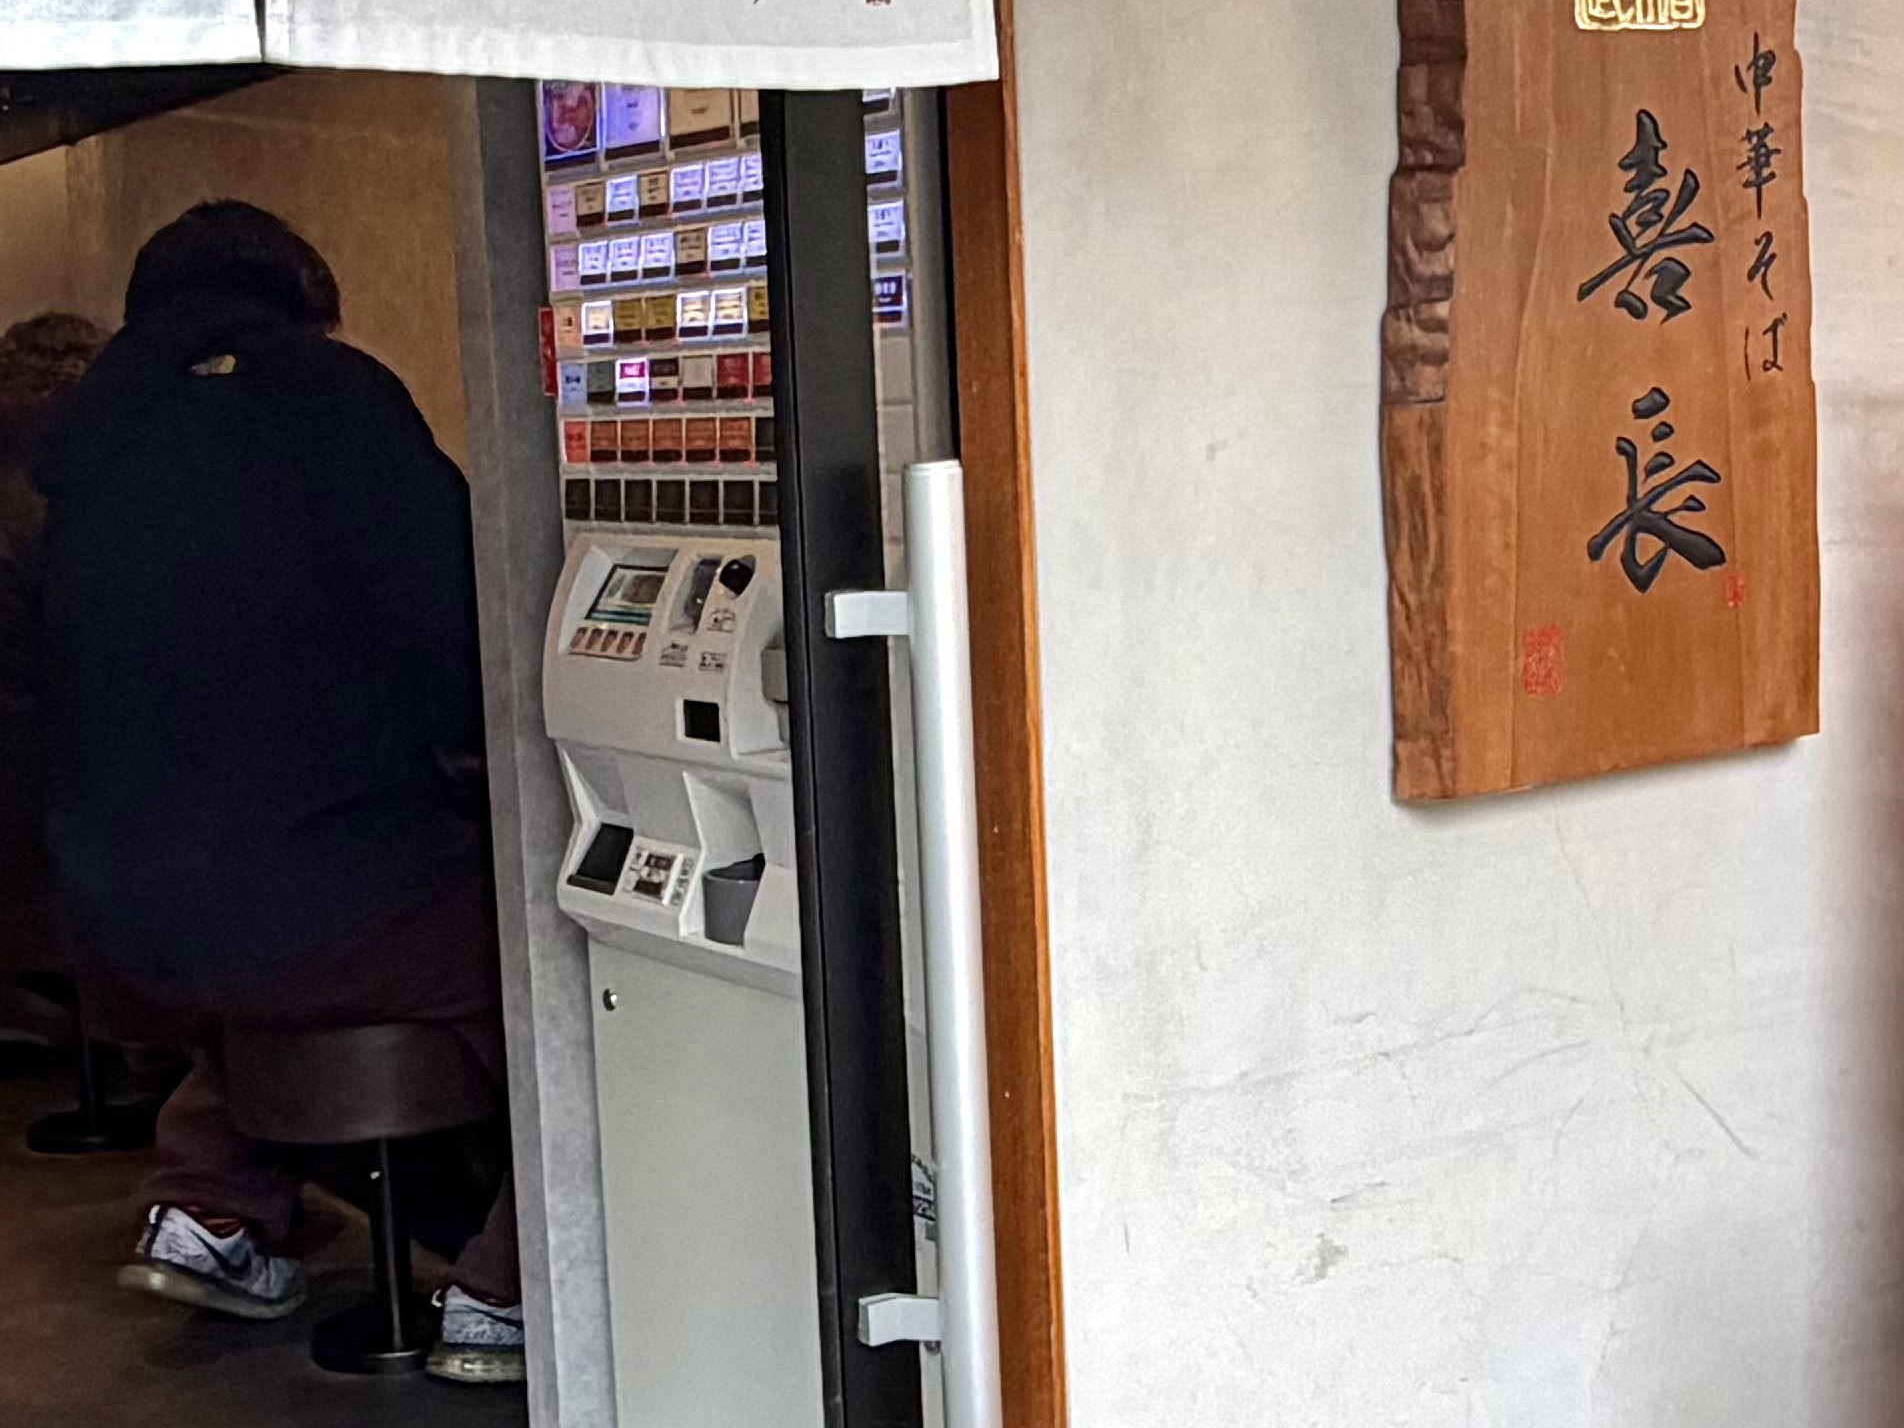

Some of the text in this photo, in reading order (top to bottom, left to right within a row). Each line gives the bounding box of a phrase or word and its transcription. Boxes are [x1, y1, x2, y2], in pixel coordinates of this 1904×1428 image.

[1576, 108, 1727, 594] 喜長
[1733, 31, 1787, 383] 中華そば
